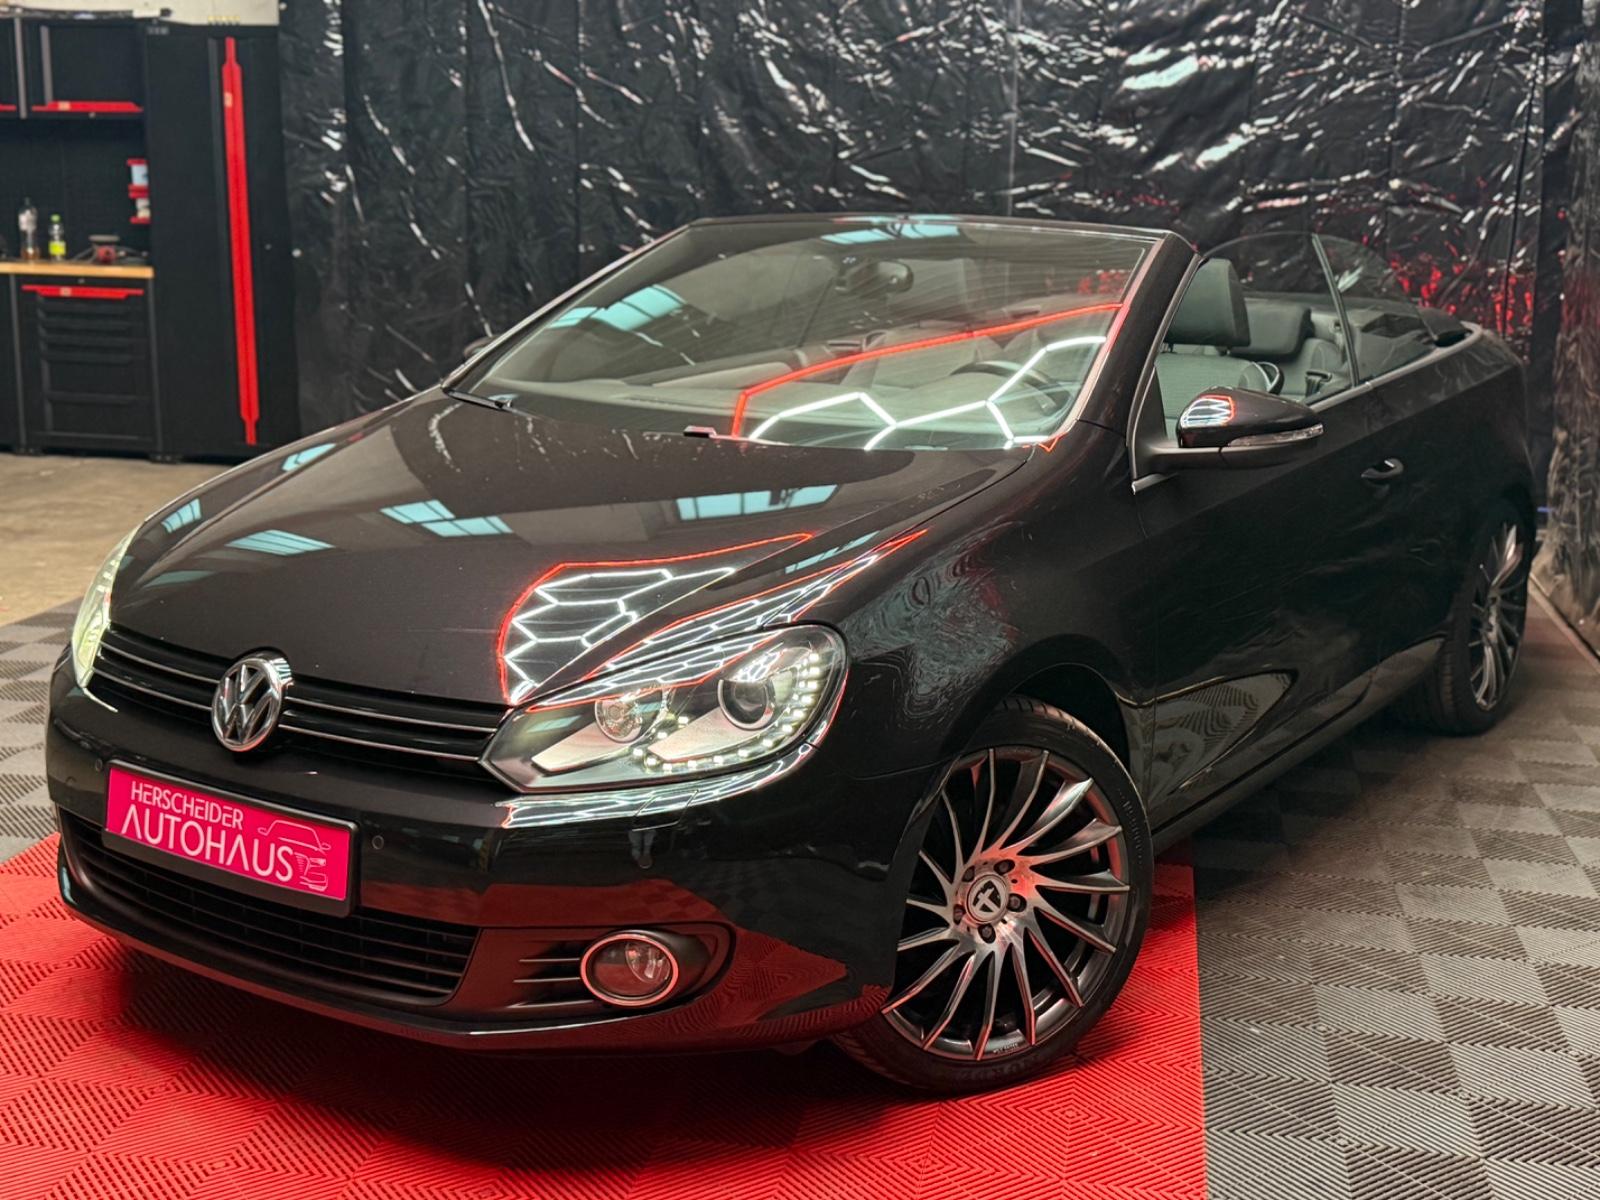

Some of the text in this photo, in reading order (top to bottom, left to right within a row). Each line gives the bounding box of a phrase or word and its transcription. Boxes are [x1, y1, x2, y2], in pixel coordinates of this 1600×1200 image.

[217, 660, 279, 747] VW
[121, 803, 294, 882] AUTOHAUS
[131, 780, 244, 830] HERSCHEIDER
